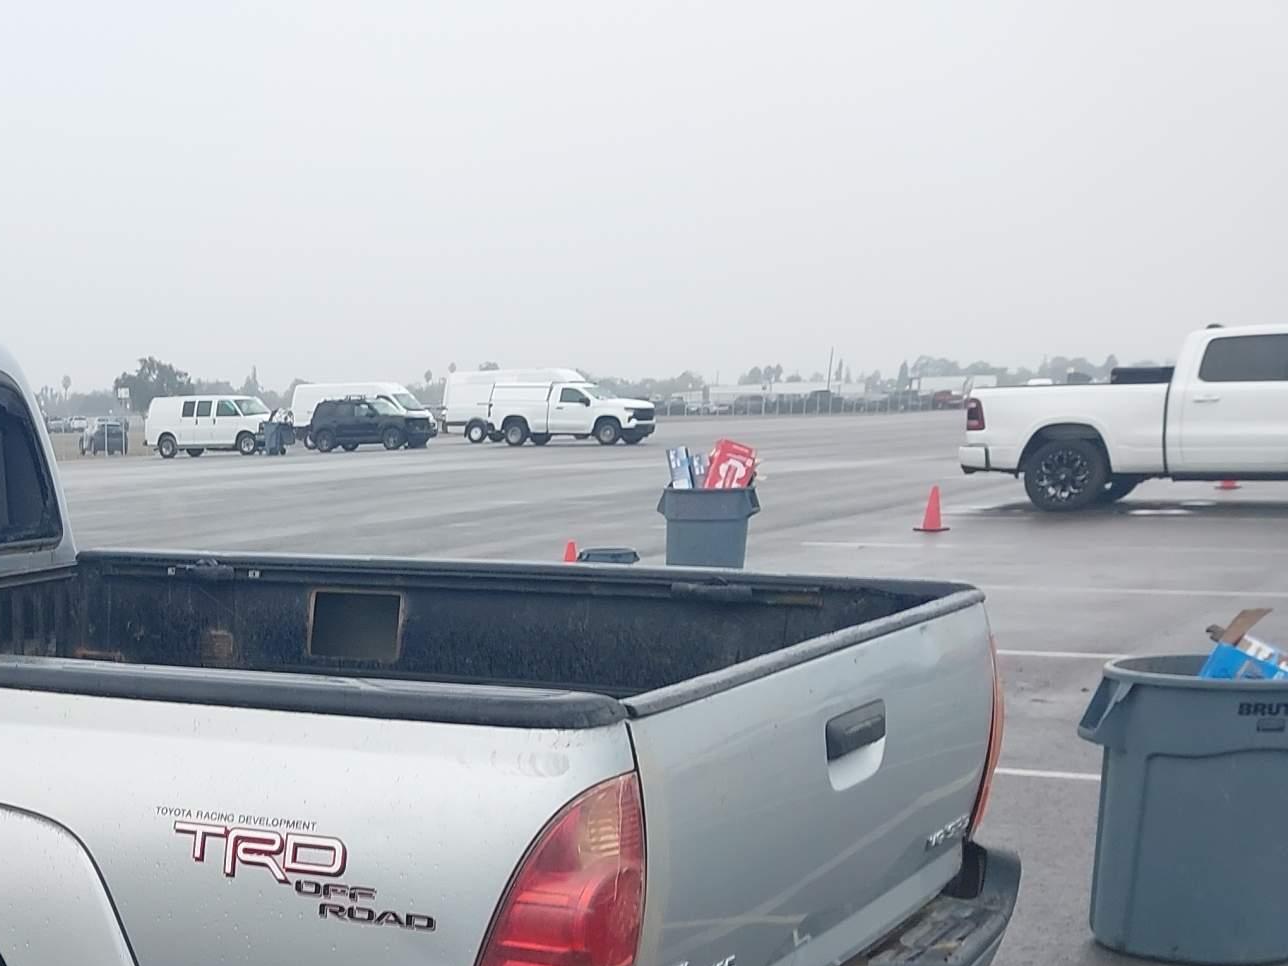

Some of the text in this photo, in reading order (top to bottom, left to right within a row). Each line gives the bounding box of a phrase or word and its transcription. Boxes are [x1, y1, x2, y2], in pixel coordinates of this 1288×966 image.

[156, 806, 317, 831] TOYOTA RACING DEVELOPMENT
[173, 820, 348, 885] TRD
[294, 879, 377, 902] OFF
[318, 902, 438, 932] ROAD
